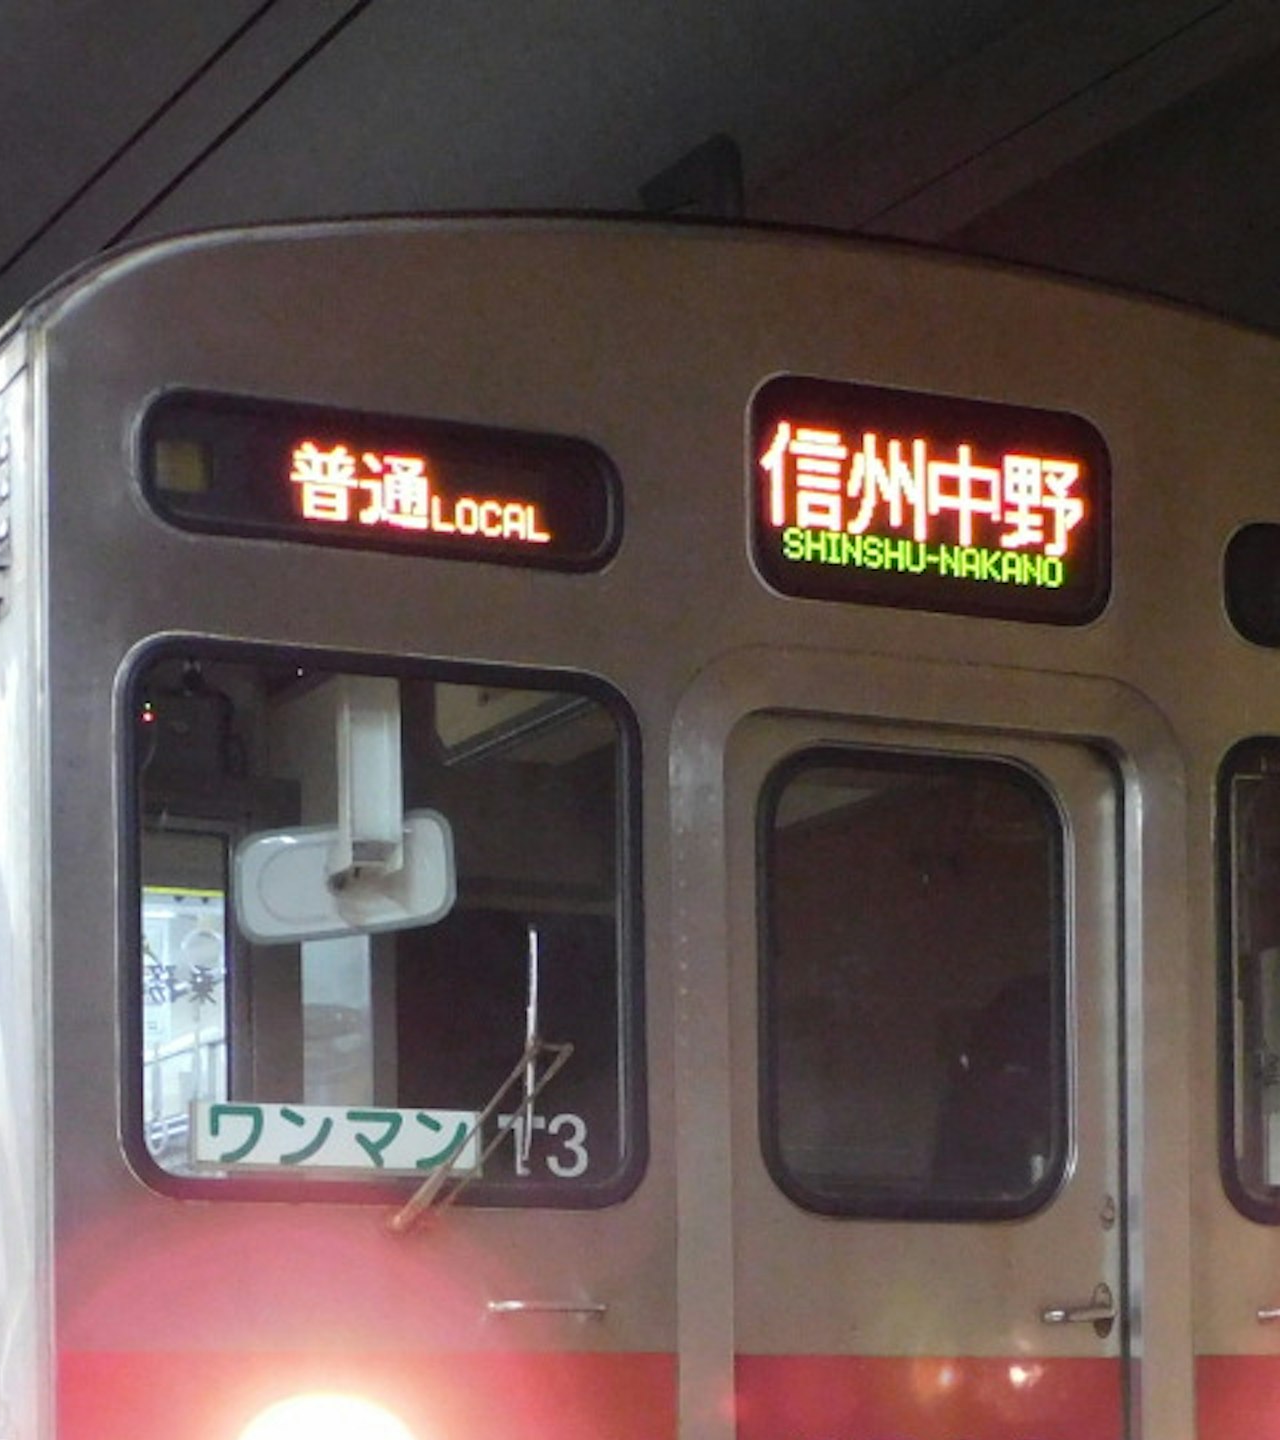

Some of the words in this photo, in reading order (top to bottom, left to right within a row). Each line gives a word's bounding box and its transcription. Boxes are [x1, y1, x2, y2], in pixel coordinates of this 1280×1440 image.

[290, 441, 430, 530] 普通
[431, 498, 551, 543] LOCAL
[760, 421, 1085, 557] 信州中野
[782, 526, 1063, 588] SHINSHU-NAKANO
[209, 1103, 467, 1169] ワンマン
[498, 1112, 588, 1178] T3
